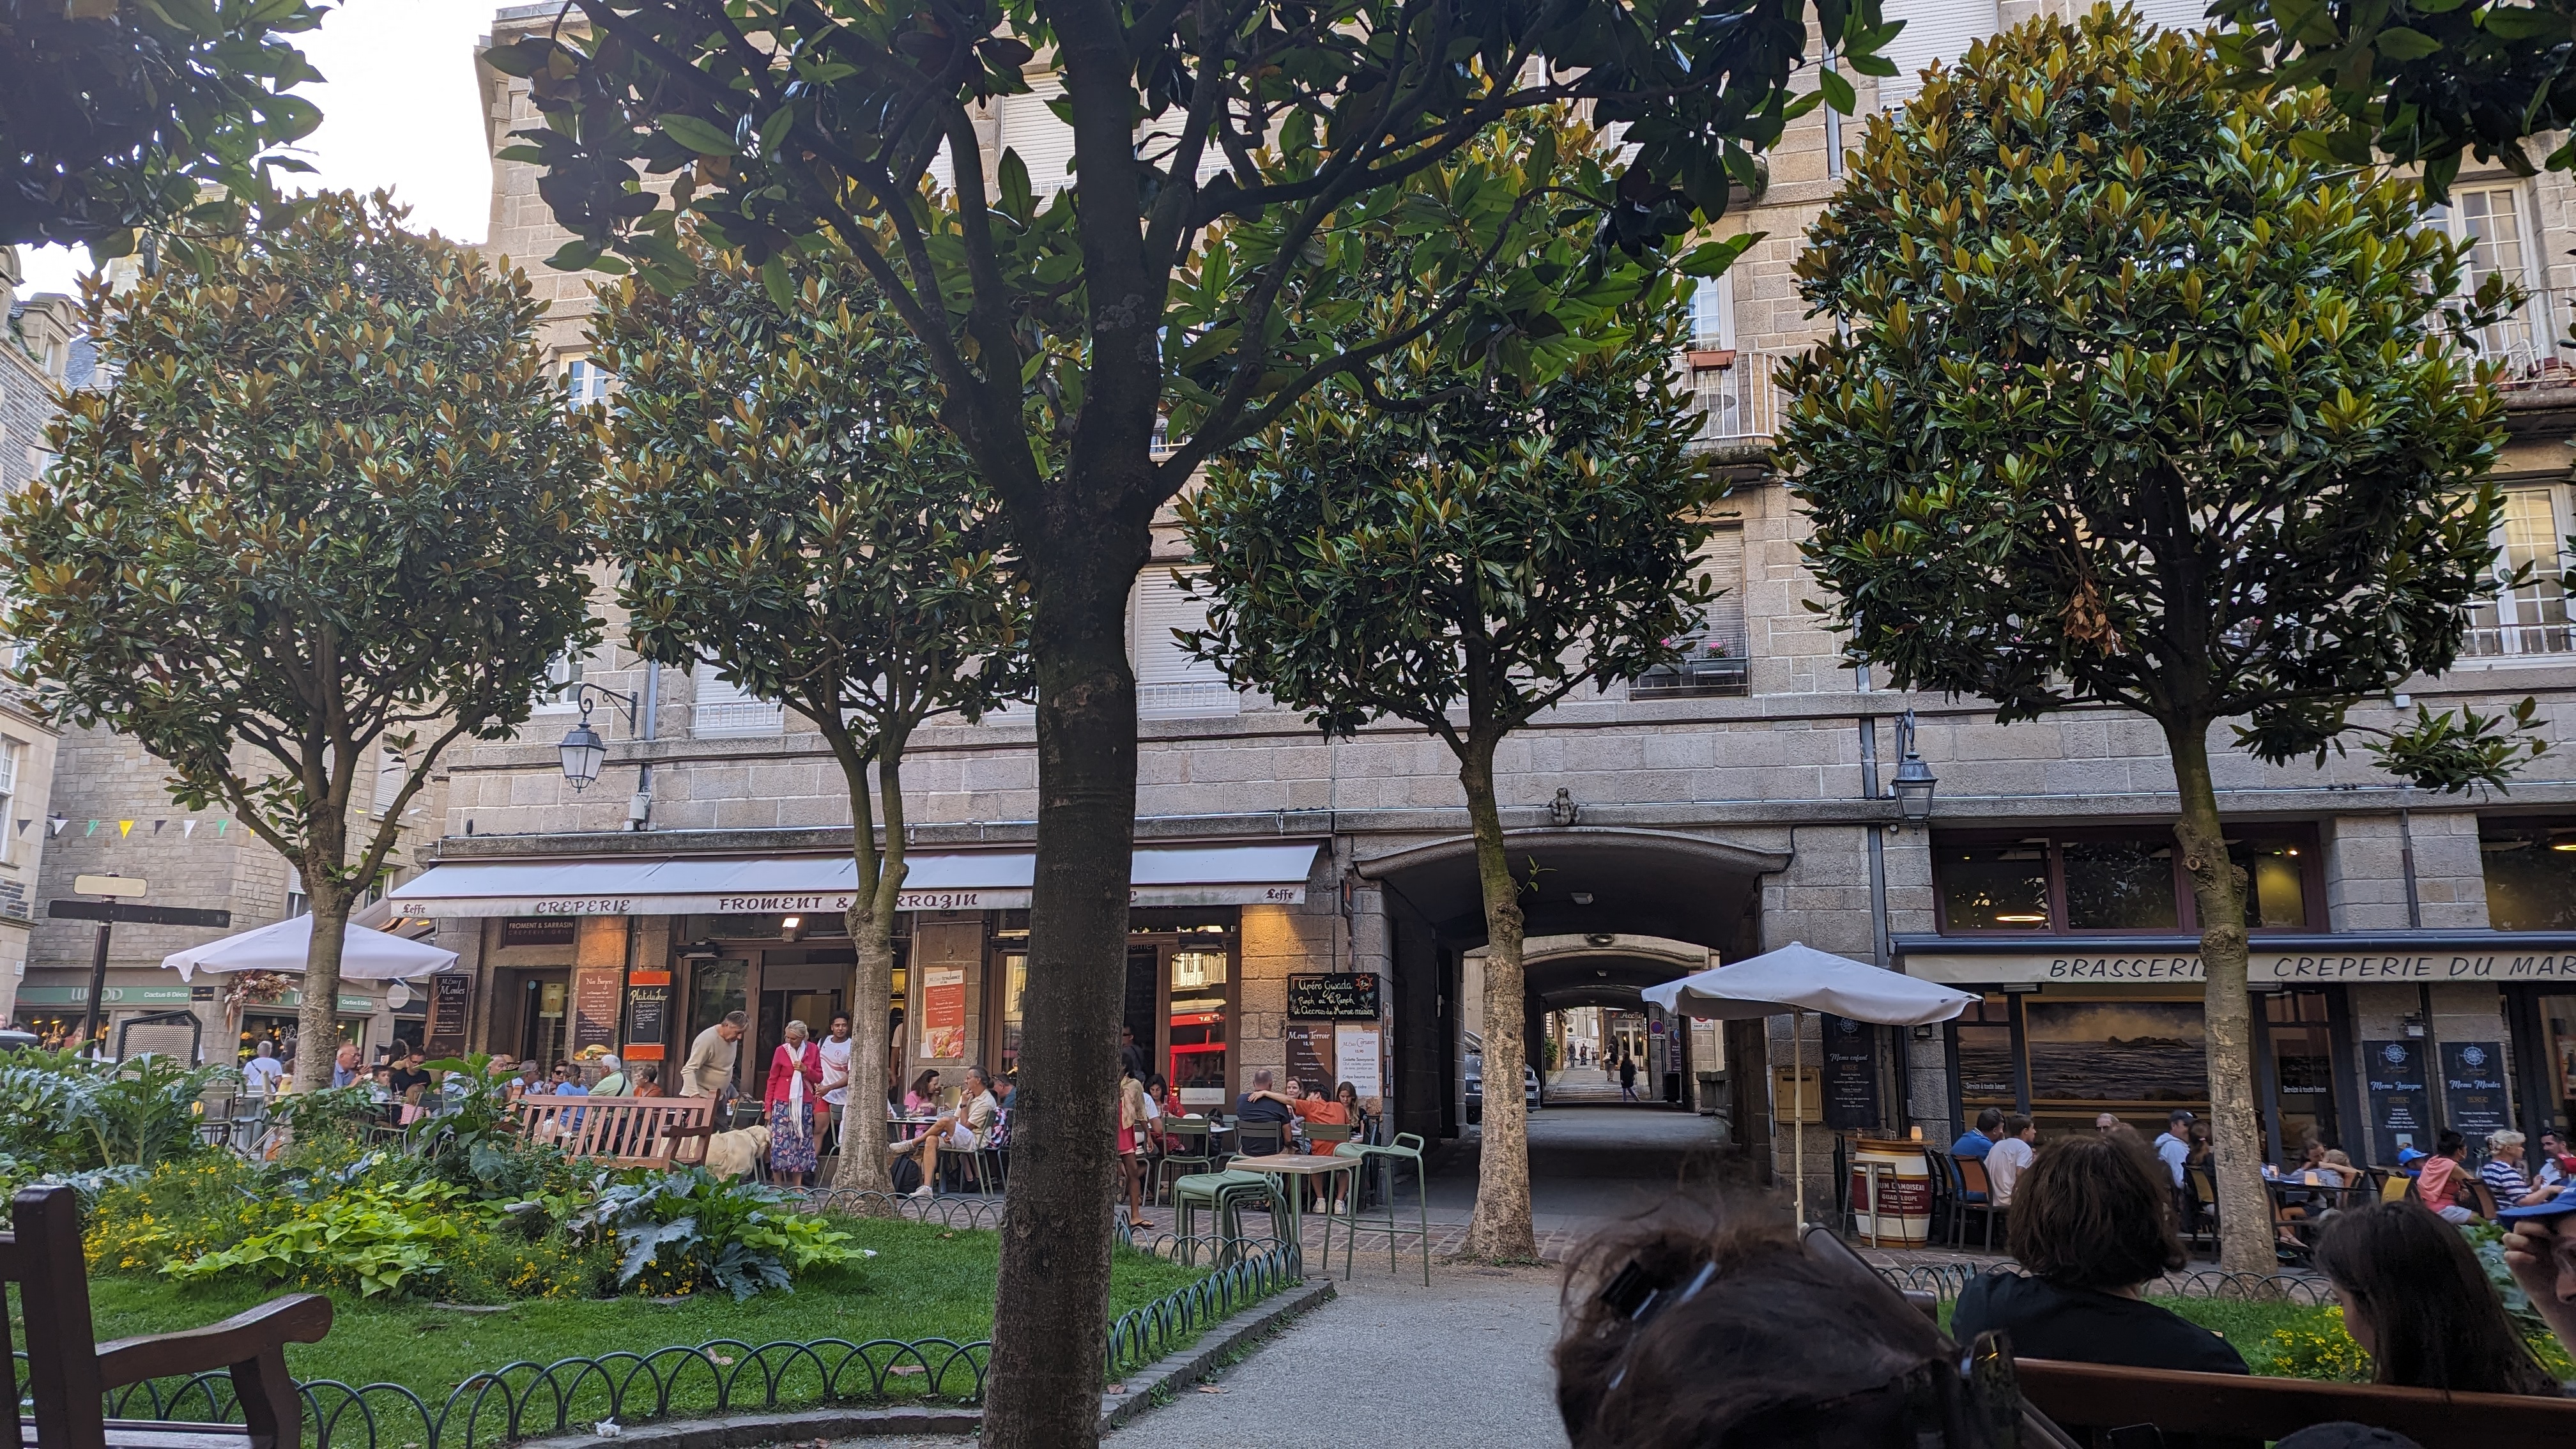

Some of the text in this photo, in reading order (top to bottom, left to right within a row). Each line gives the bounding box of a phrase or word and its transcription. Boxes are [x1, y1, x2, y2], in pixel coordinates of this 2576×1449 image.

[1266, 888, 1293, 901] Leffe
[536, 899, 631, 914] CREPERIE
[719, 893, 978, 910] FROMENT & RRAZIN
[402, 903, 426, 915] Leffe
[2274, 957, 2434, 977] CREPERIE
[2449, 957, 2495, 976] DU
[1299, 978, 1353, 998] Apéro Gwada
[1298, 995, 1315, 1006] Punch
[1286, 1029, 1331, 1041] Menu Terroir
[2370, 1081, 2423, 1092] Menu Lasagne
[2449, 1080, 2501, 1089] Menu Moules
[1882, 1193, 1918, 1202] GUADLOUPE
